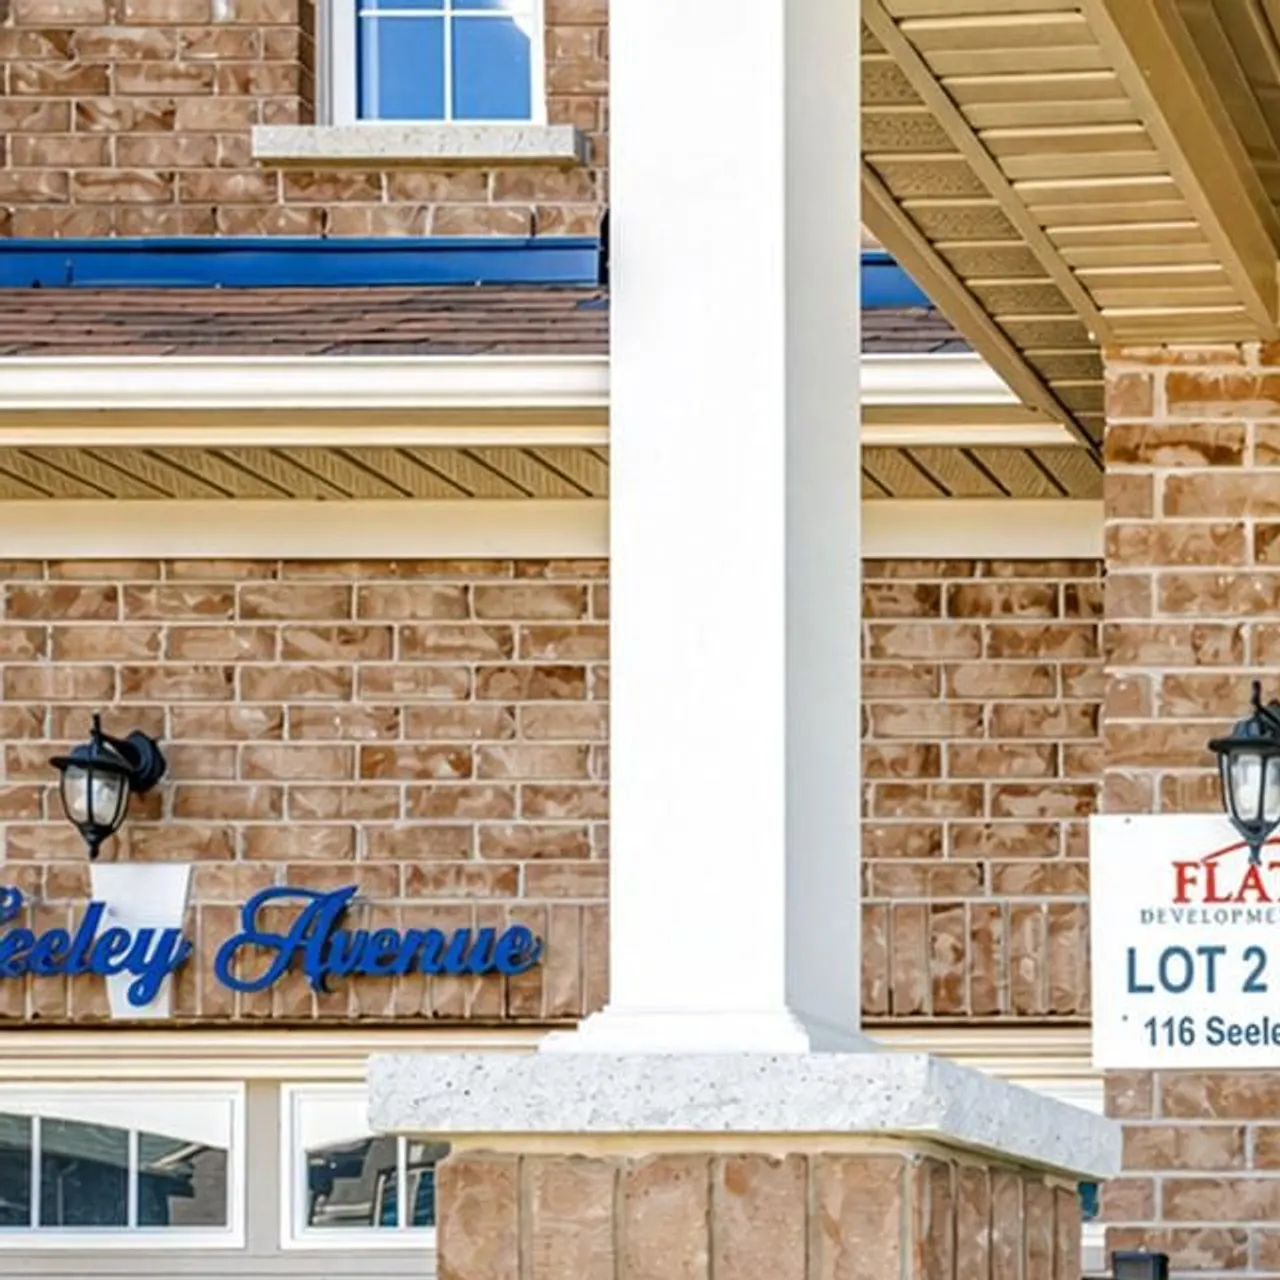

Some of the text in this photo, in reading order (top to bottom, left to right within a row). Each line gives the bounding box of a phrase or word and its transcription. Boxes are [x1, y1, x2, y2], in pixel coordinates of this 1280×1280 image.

[214, 884, 543, 994] Avenue
[1127, 946, 1226, 993] LOT
[1242, 946, 1268, 992] 2
[1144, 1016, 1195, 1046] 116
